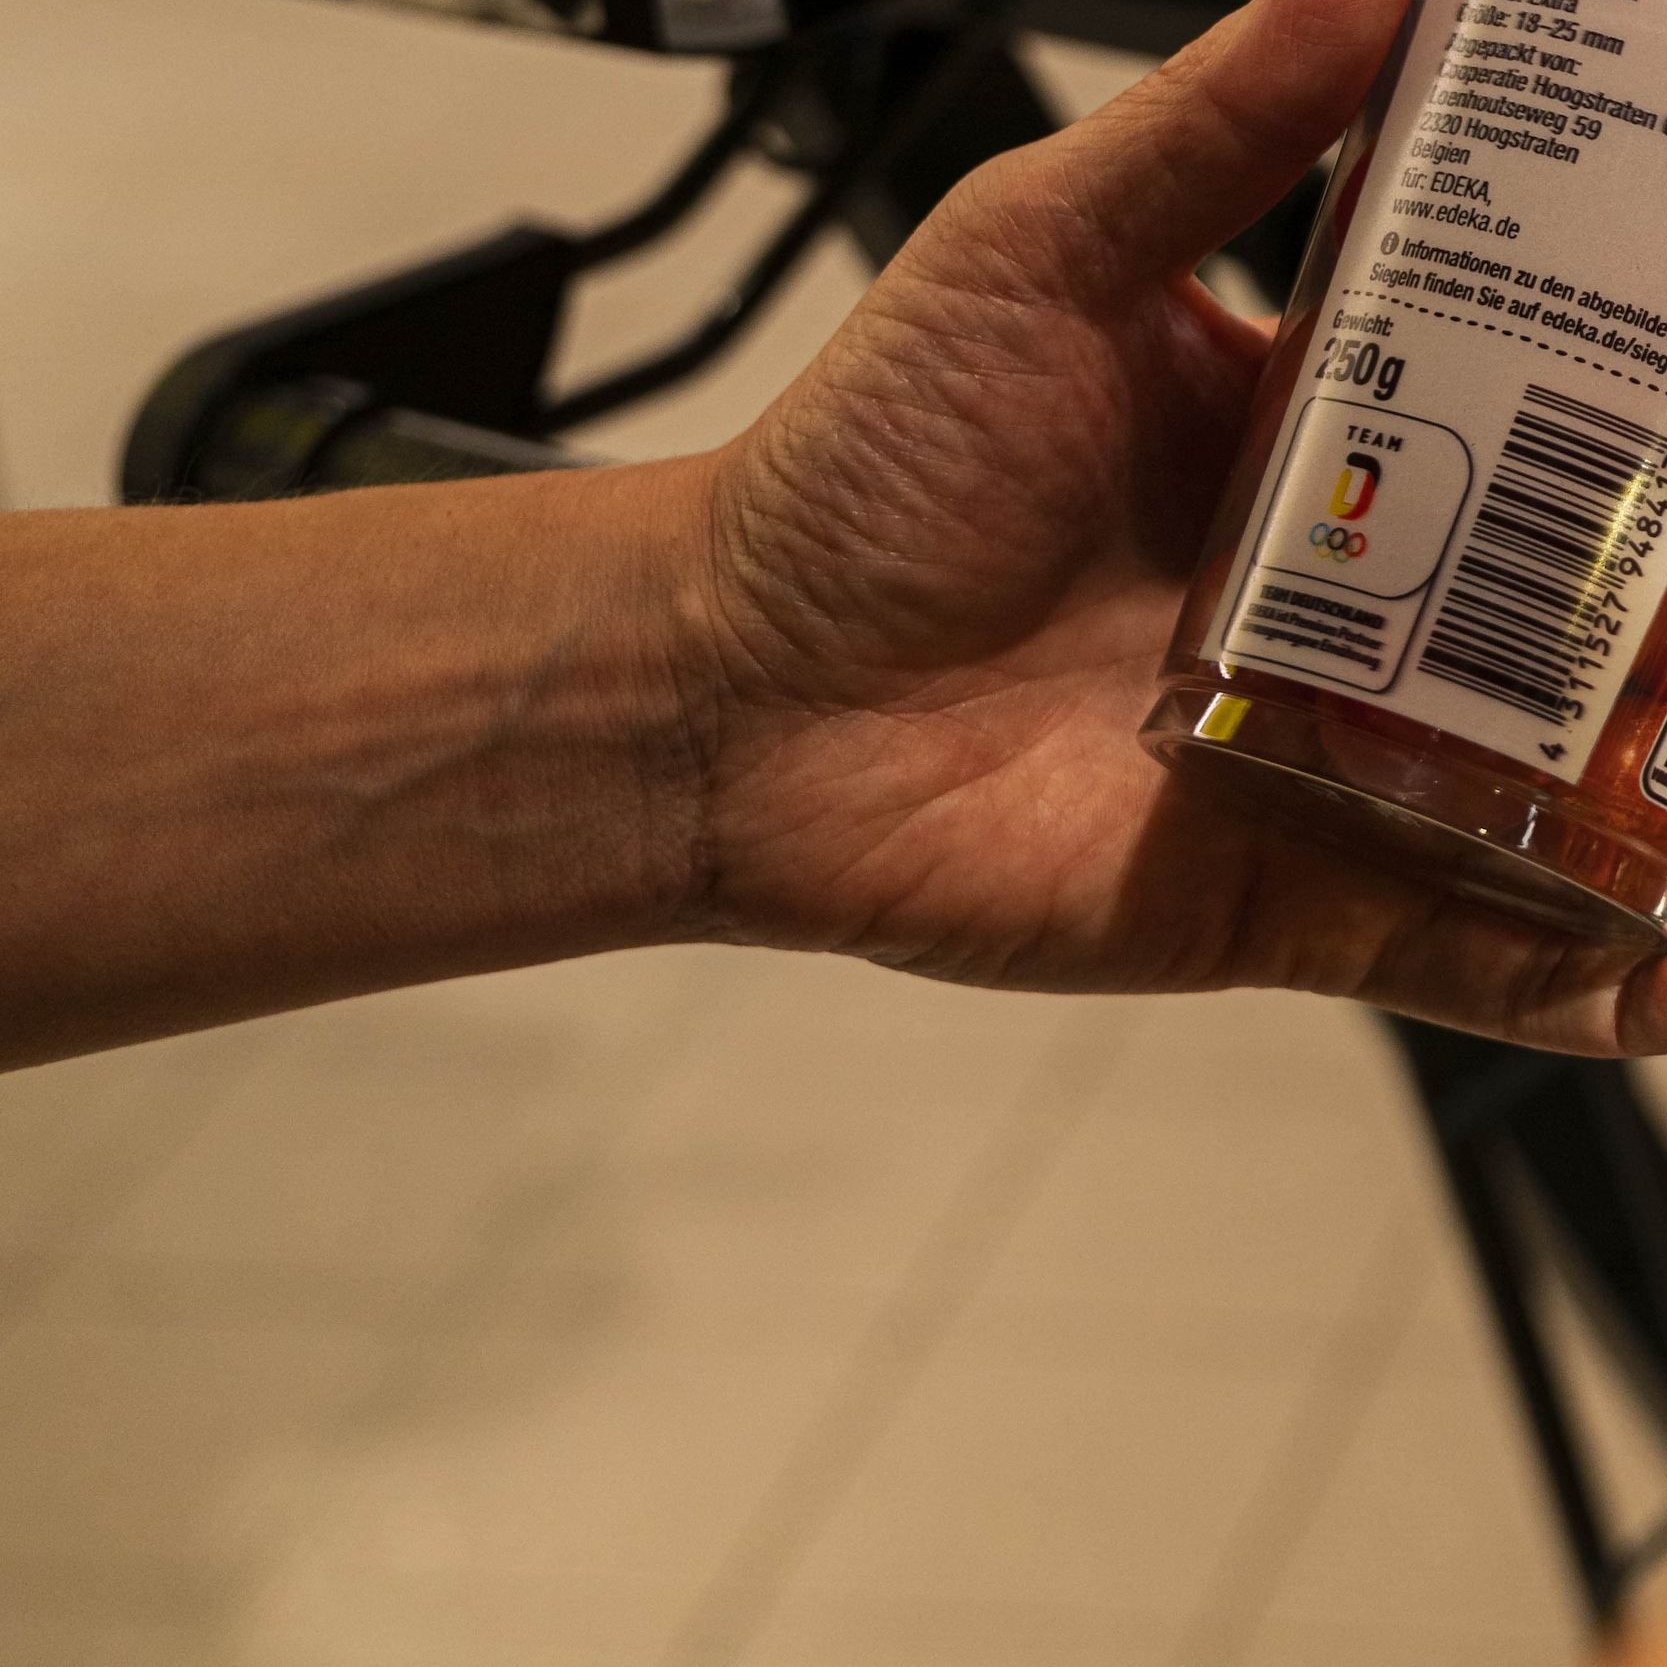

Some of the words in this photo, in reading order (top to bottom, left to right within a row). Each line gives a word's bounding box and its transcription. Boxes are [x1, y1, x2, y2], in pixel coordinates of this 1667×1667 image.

[1580, 29, 1626, 55] mm
[1539, 50, 1583, 76] von:
[1532, 74, 1658, 130] Hoogstraten
[1420, 112, 1462, 136] 2320
[1464, 118, 1580, 164] Hoogstraten
[1570, 117, 1604, 141] 59
[1411, 137, 1471, 166] Belgien
[1400, 167, 1428, 190] für:
[1430, 171, 1493, 207] EDEKA,
[1392, 197, 1521, 241] www.edeka.de
[1401, 237, 1512, 282] Informationen
[1514, 268, 1538, 289] zu
[1540, 276, 1576, 304] den
[1369, 262, 1420, 290] Siegeln
[1423, 271, 1475, 303] finden
[1476, 285, 1506, 311] Sie
[1507, 298, 1541, 322] auf
[1332, 309, 1395, 338] Gewicht:
[1347, 423, 1406, 453] TEAM
[1537, 740, 1568, 763] 4
[1553, 590, 1628, 723] 311527
